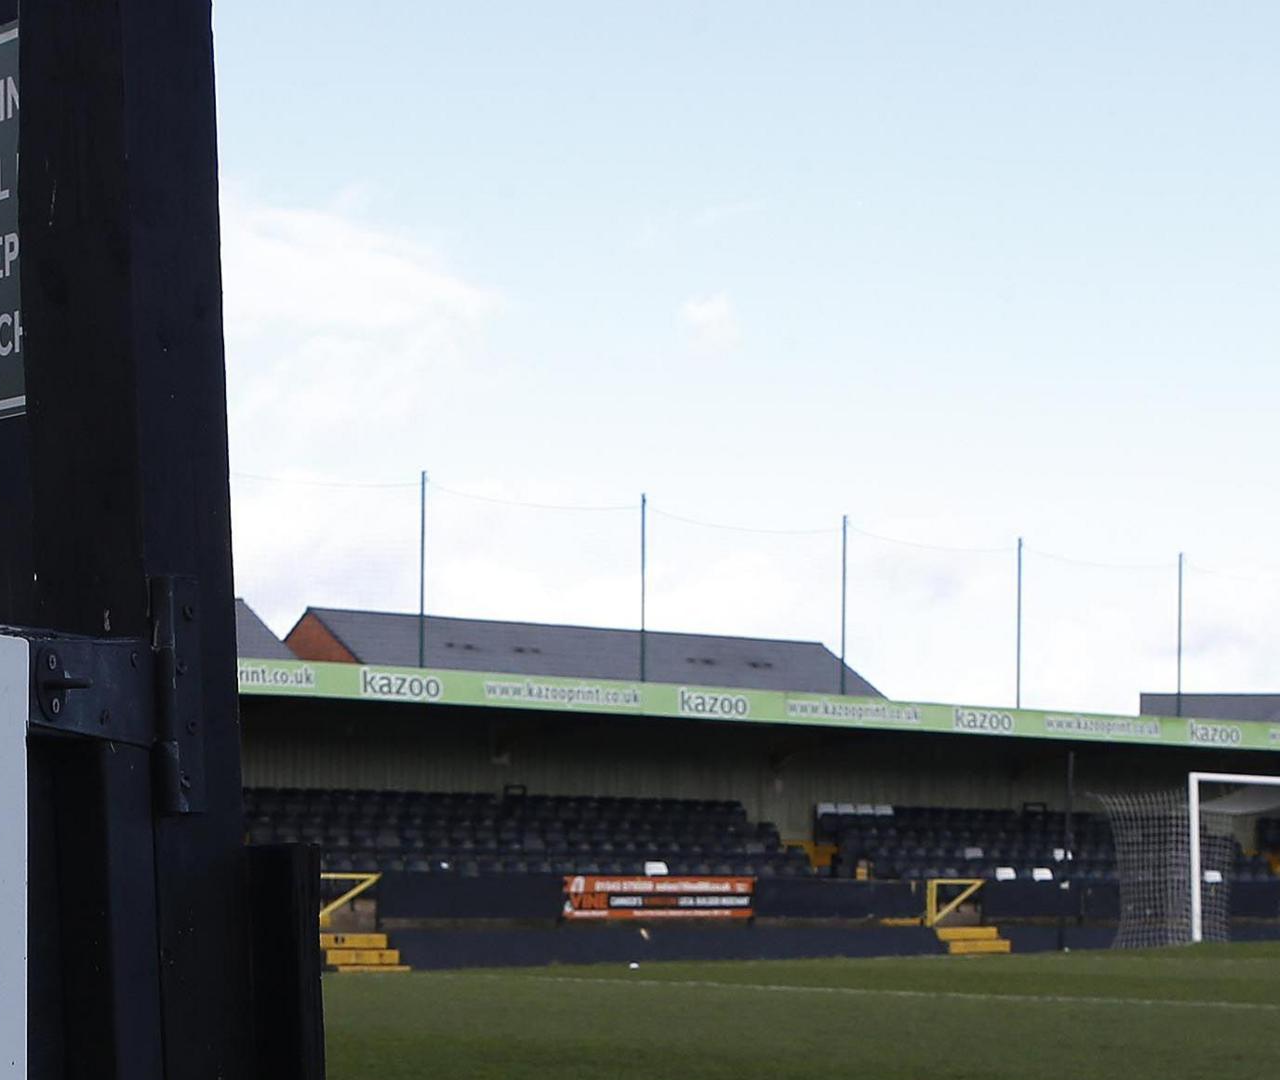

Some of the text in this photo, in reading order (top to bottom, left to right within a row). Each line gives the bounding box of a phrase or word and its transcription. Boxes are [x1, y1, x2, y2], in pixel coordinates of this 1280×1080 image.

[362, 670, 441, 698] kazoo
[680, 689, 747, 716] kazoo
[954, 707, 1013, 731] kazoo
[1189, 720, 1241, 745] kazoo
